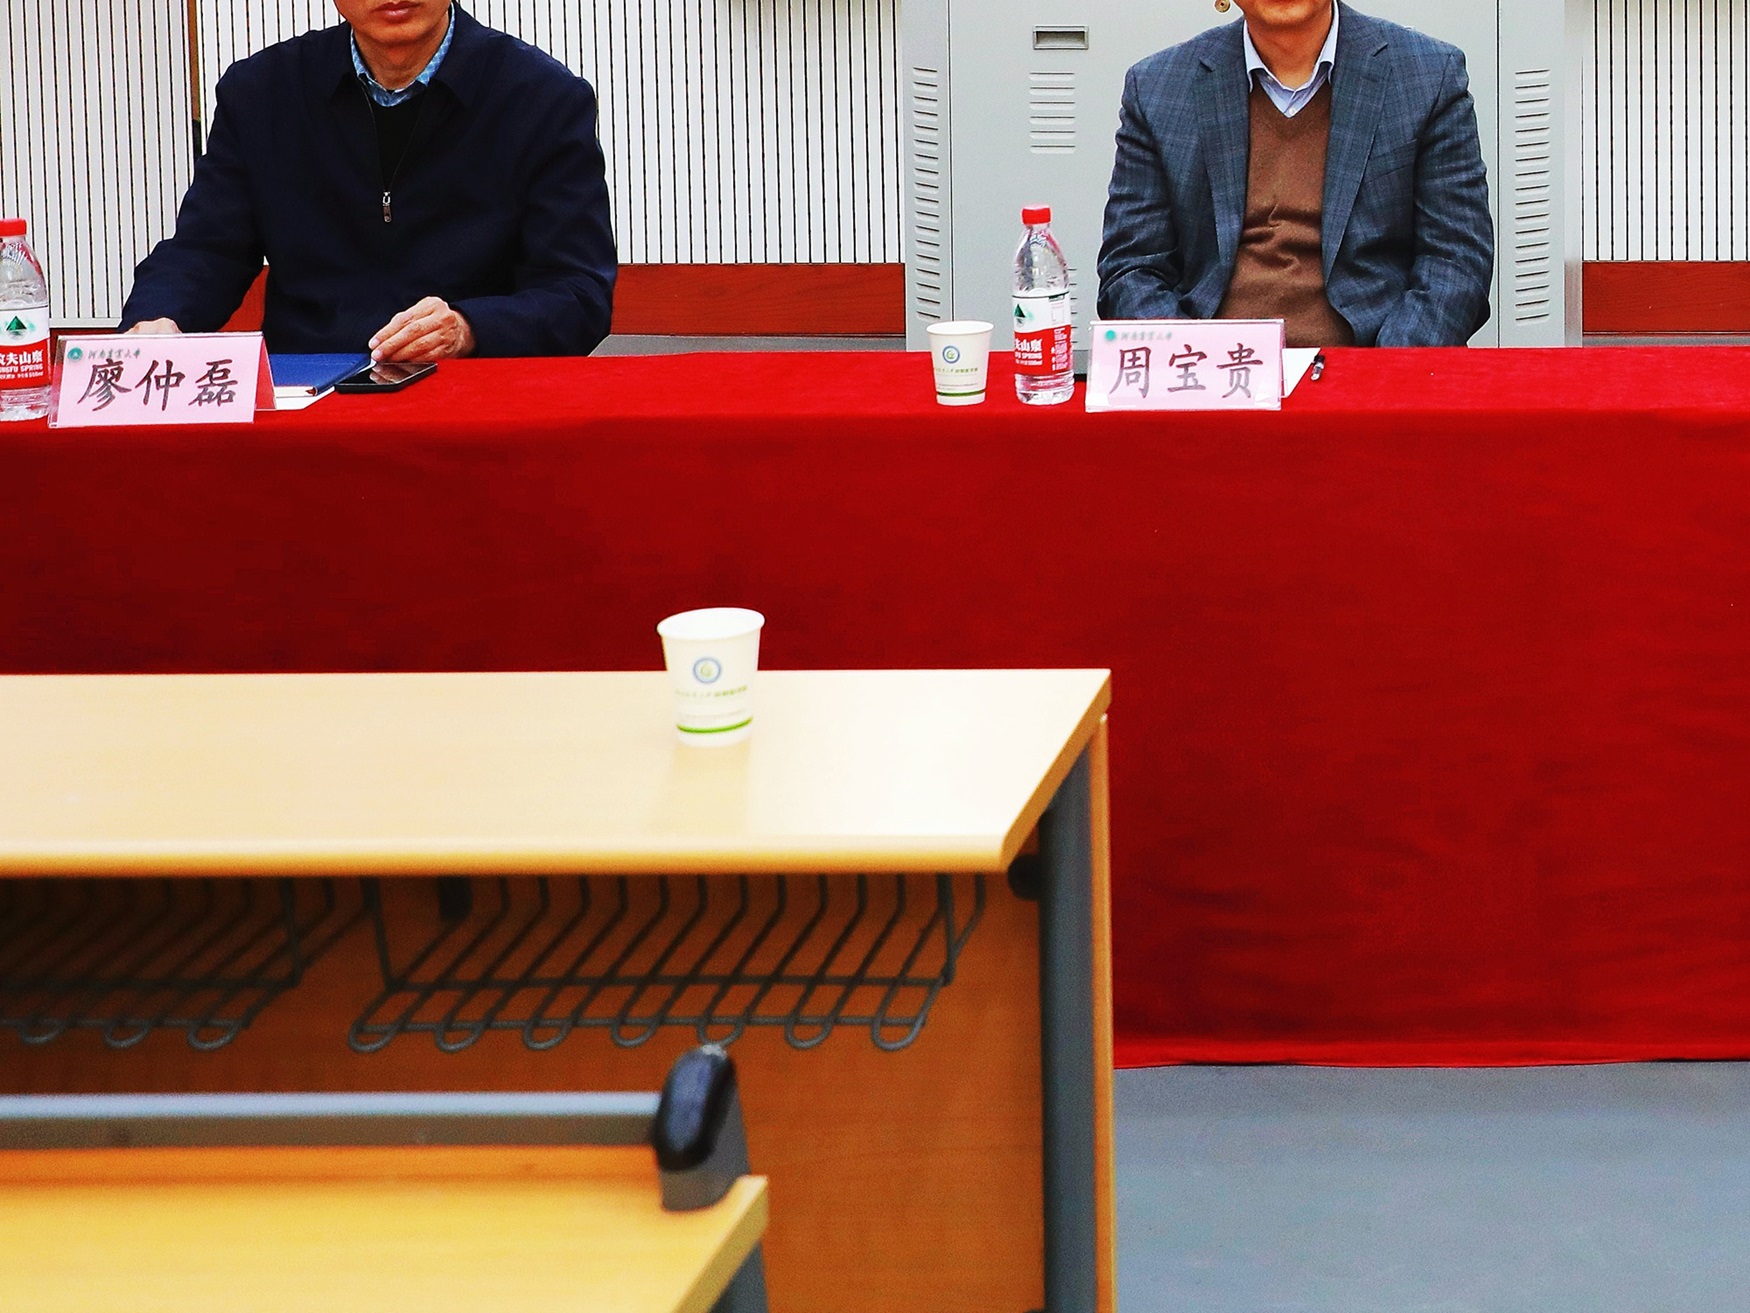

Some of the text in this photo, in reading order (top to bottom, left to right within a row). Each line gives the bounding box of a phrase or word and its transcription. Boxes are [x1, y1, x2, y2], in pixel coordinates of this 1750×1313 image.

[77, 358, 238, 412] 廖仲磊
[1109, 342, 1263, 399] 周宝贵
